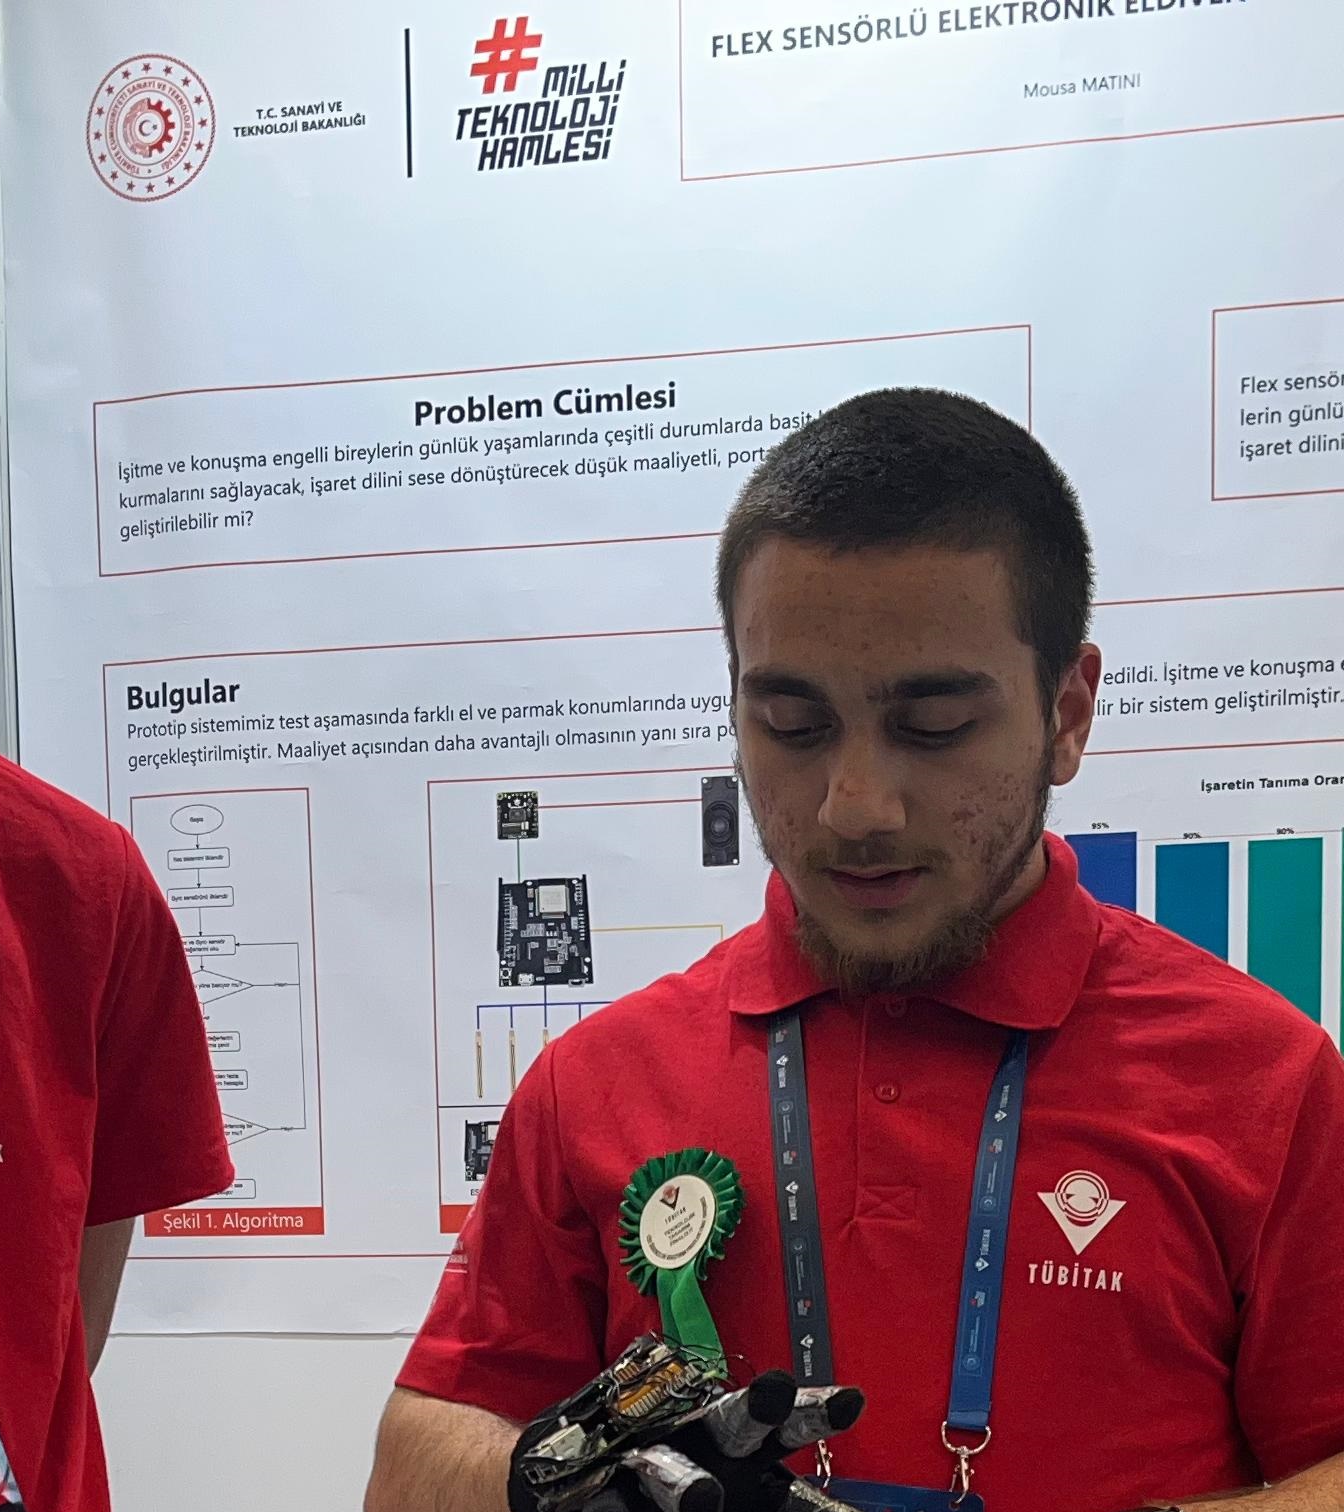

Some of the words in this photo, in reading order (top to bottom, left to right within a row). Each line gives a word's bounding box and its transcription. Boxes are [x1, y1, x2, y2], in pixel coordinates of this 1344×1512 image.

[711, 29, 774, 59] FLEX
[781, 7, 927, 52] SENSÖRLÜ
[541, 59, 627, 99] MİLLİ
[1023, 81, 1077, 99] Mousa
[1081, 72, 1141, 93] MATINI
[233, 120, 299, 138] TEKNOLOJİ
[301, 113, 366, 133] BAKANLIĞI
[256, 107, 278, 120] T.C.
[280, 100, 325, 118] SANAYİ
[327, 100, 343, 114] VE
[456, 94, 620, 141] TEKNOLOJİ
[477, 127, 613, 172] HAMLESİ
[1240, 375, 1279, 395] Flex
[414, 393, 543, 427] Problem
[552, 380, 676, 417] Cümlesi
[1239, 406, 1283, 427] lerin
[117, 460, 164, 485] İşitme
[166, 460, 186, 475] ve
[190, 454, 268, 473] konuşma
[272, 445, 329, 470] engelli
[334, 440, 414, 466] bireylerin
[418, 434, 480, 461] günlük
[483, 426, 599, 458] yaşamlarında
[604, 421, 654, 448] çeşitli
[659, 414, 764, 440] durumlarda
[118, 486, 205, 510] kurmalarını
[209, 476, 306, 504] sağlayacak,
[309, 474, 358, 498] işaret
[361, 469, 403, 491] dilini
[407, 471, 446, 487] sese
[450, 458, 570, 486] dönüştürecek
[574, 454, 629, 479] düşük
[633, 447, 722, 473] maaliyetli,
[119, 511, 220, 543] geliştirilebilir
[223, 509, 255, 529] mi?
[1103, 665, 1158, 687] edildi.
[1163, 660, 1220, 687] İşitme
[1222, 663, 1246, 679] ve
[1249, 658, 1336, 679] konuşma
[126, 677, 241, 715] Bulgular
[127, 711, 188, 741] Prototip
[189, 713, 276, 735] sistemimiz
[278, 713, 311, 731] test
[313, 706, 410, 733] aşamasında
[412, 704, 455, 724] farklı
[458, 703, 474, 722] el
[476, 706, 498, 721] ve
[501, 698, 565, 725] parmak
[568, 692, 687, 717] konumlarında
[1200, 778, 1255, 795] İşaretin
[1257, 777, 1310, 790] Tanıma
[162, 1209, 201, 1234] Şekil
[204, 1212, 218, 1230] 1.
[222, 1210, 304, 1234] Algoritma
[1028, 1260, 1124, 1292] TÜBİTAK
